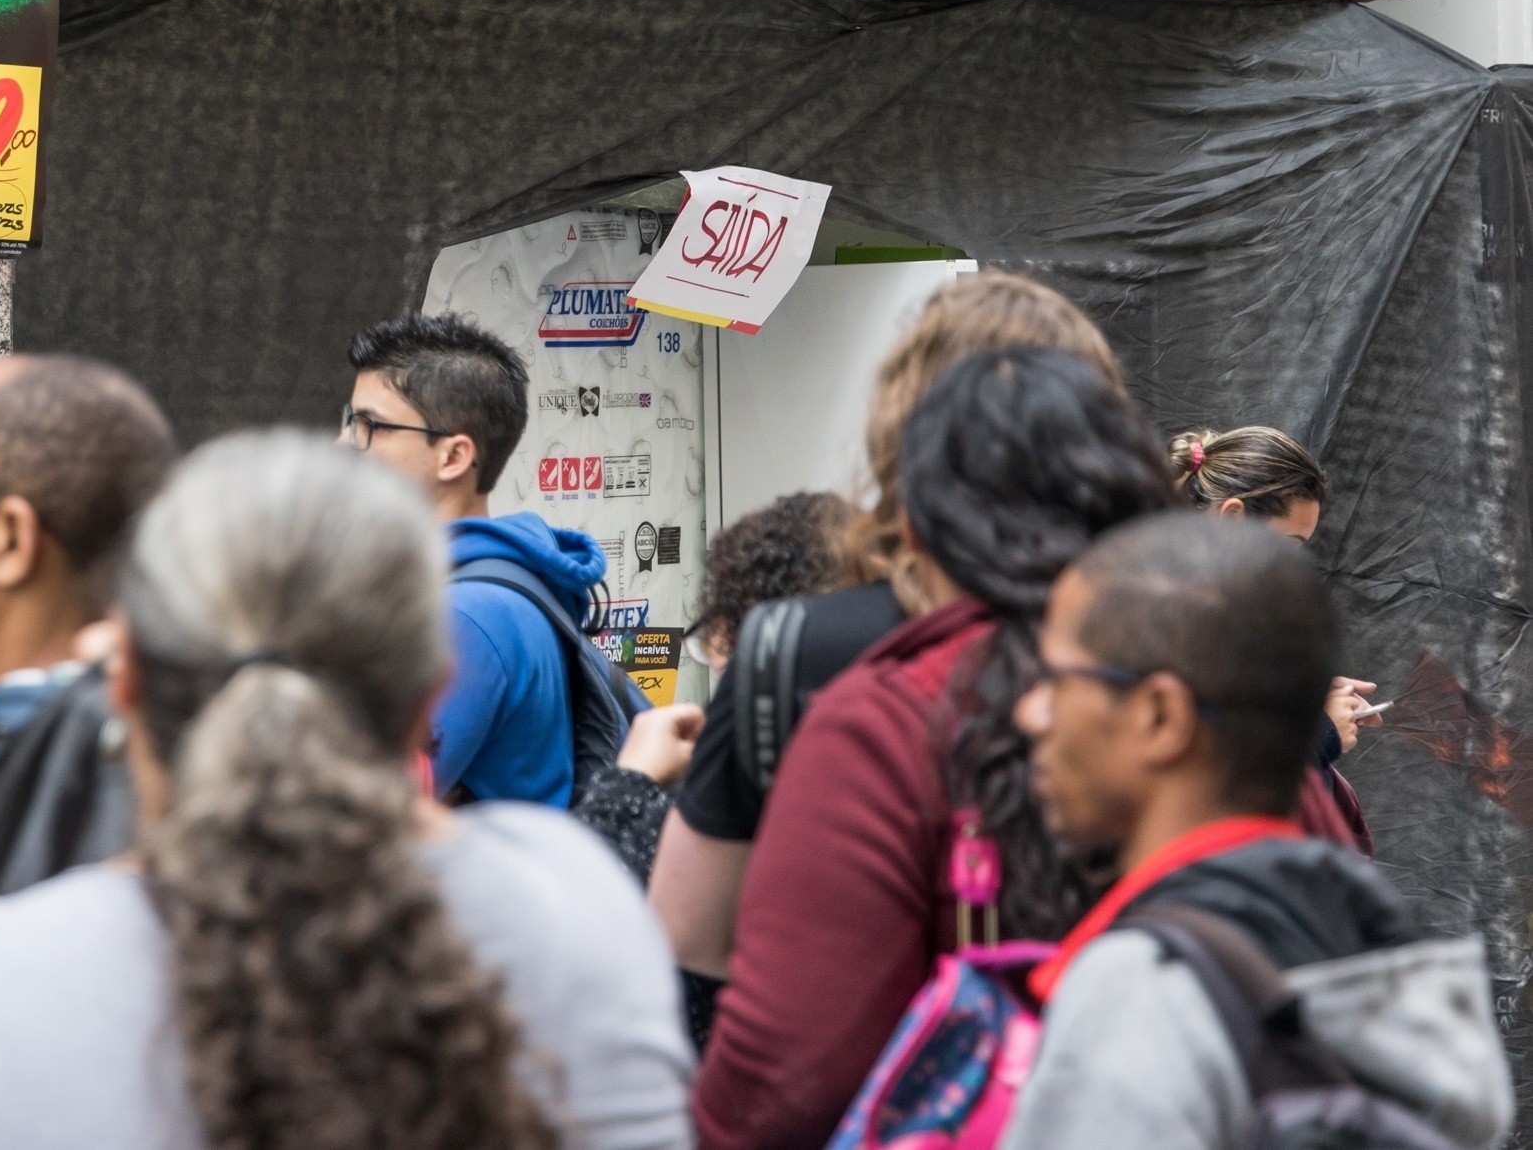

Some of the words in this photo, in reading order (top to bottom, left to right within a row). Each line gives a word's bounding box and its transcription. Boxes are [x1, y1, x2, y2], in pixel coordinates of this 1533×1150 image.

[681, 193, 788, 283] SAÍDA
[657, 332, 680, 353] 138
[637, 538, 654, 546] ABICOL
[636, 634, 670, 644] OFERTA
[634, 644, 670, 654] INCRÍVEL
[635, 656, 650, 664] PARA
[650, 655, 667, 663] VOCÊ!
